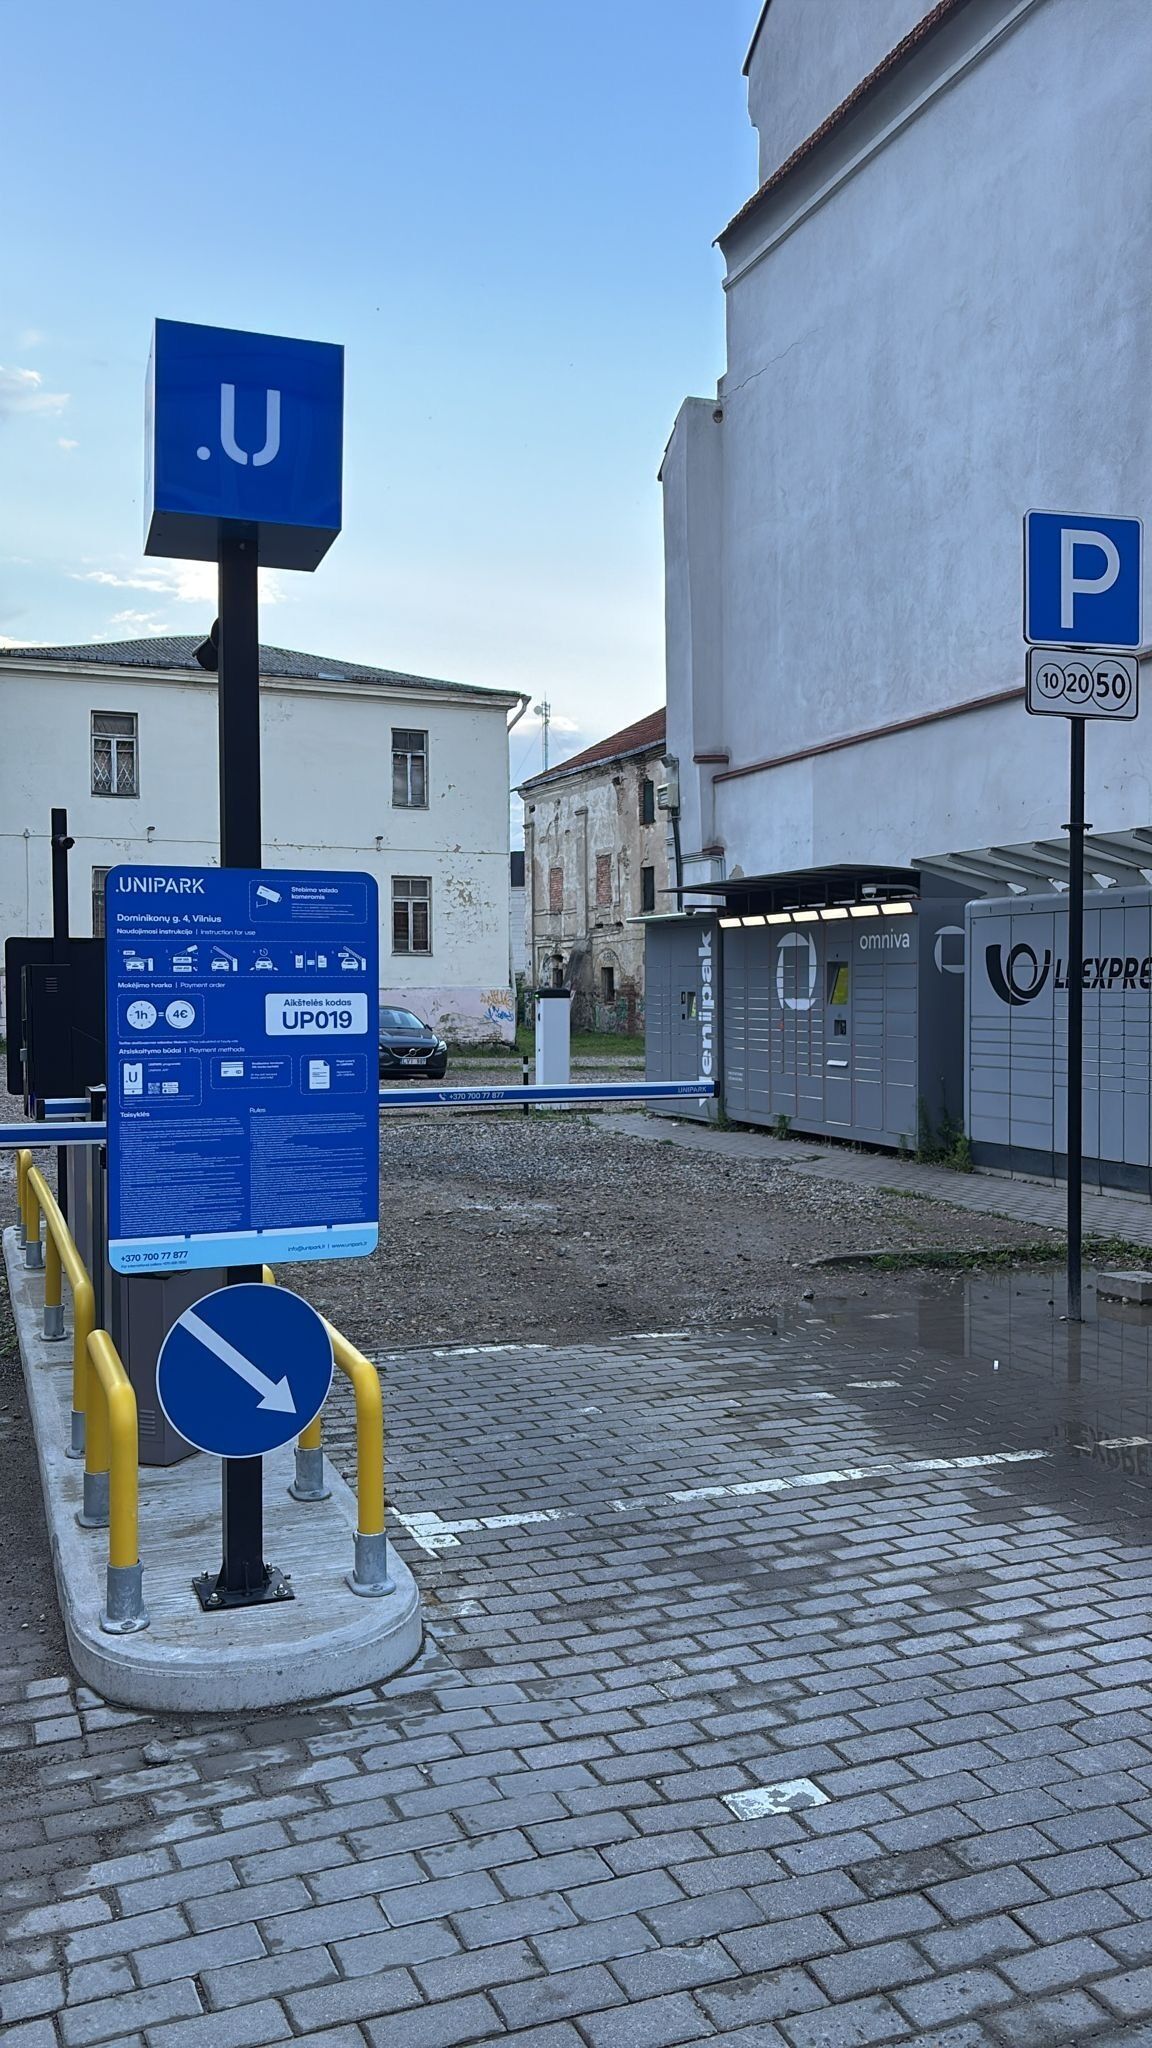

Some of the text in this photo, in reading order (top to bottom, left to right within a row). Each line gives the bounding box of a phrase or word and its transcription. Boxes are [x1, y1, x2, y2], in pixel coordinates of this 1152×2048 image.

[1060, 528, 1121, 629] P
[1043, 672, 1126, 699] 10 20 50
[1119, 895, 1126, 904] 4
[116, 913, 222, 924] Dominikonų g. 4, Vilnius
[116, 928, 158, 936] Naudojimosi
[158, 928, 193, 936] instrukcija
[234, 928, 243, 936] for
[859, 928, 910, 950] omniva
[180, 982, 208, 990] Payment
[283, 998, 352, 1007] Aikštelės kodas
[134, 1010, 148, 1020] 1h
[172, 1009, 188, 1019] 4€
[282, 1010, 353, 1030] UP019
[449, 1091, 505, 1100] +370 700 77 877
[120, 1111, 151, 1119] Taisyklės
[249, 1106, 267, 1114] Rules
[120, 1250, 189, 1263] +370 700 77 877
